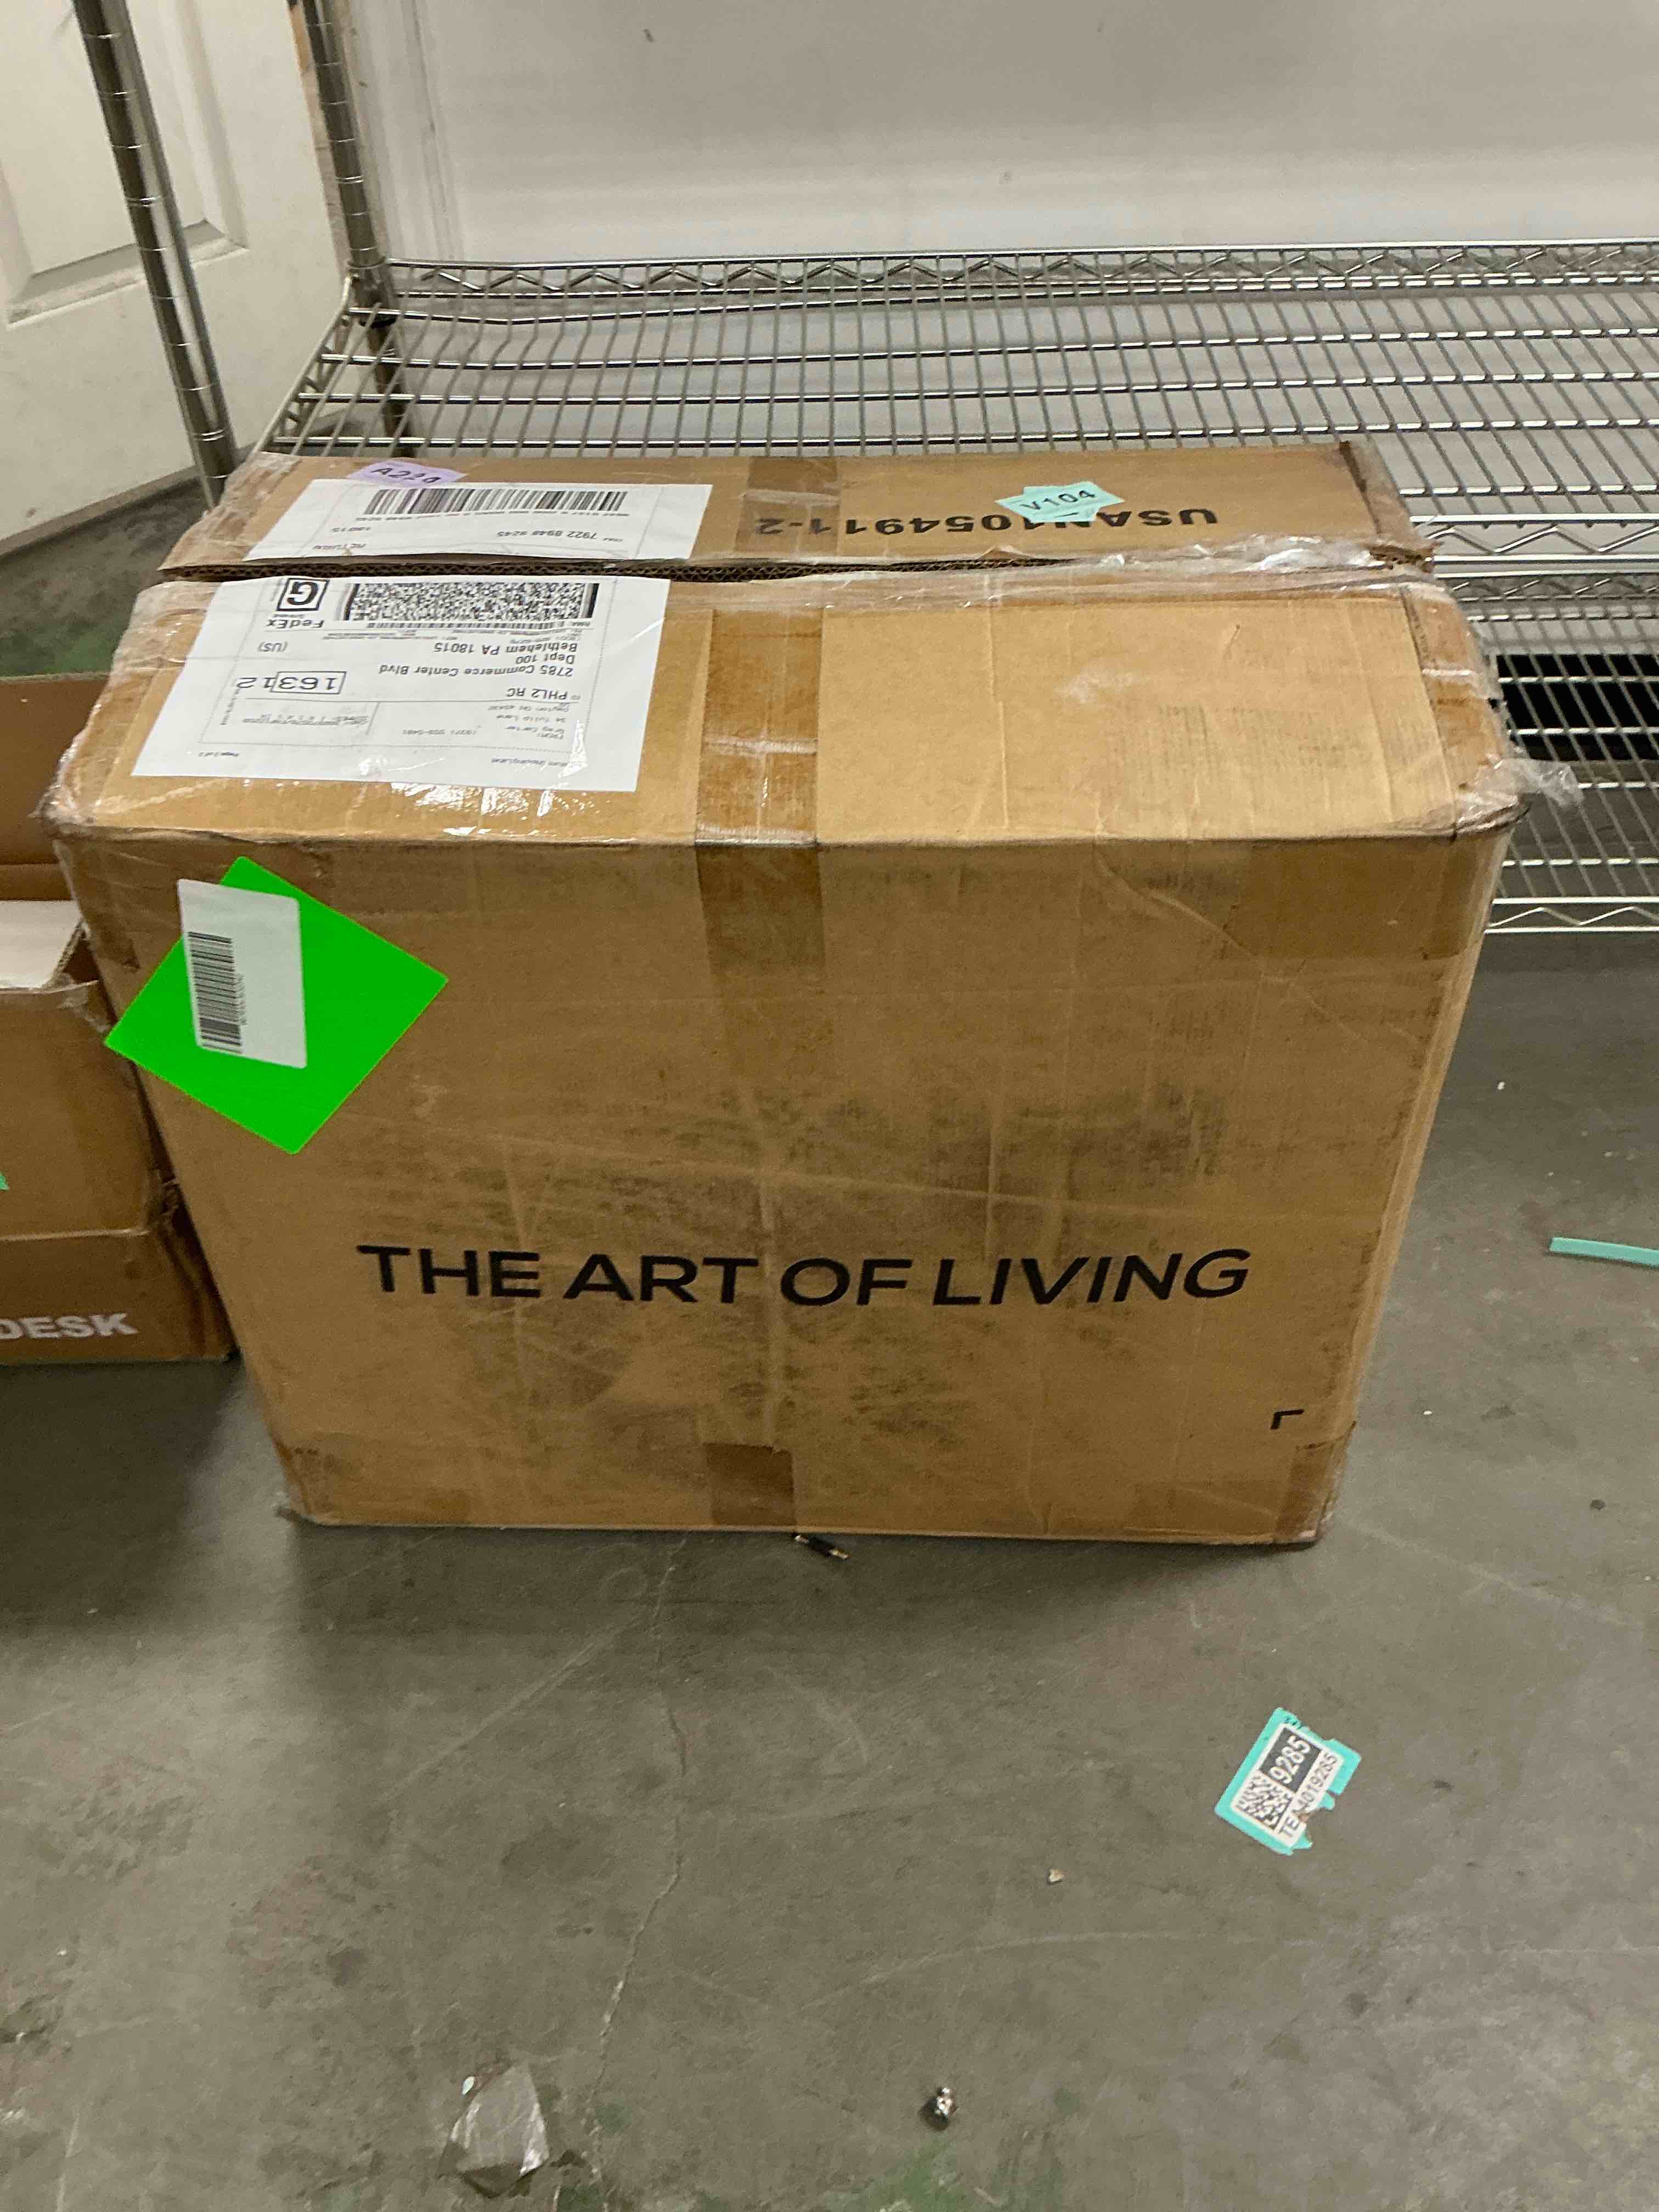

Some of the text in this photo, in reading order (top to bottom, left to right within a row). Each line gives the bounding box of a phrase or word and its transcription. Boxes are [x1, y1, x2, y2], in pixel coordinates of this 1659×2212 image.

[1019, 490, 1096, 510] V104
[755, 509, 1219, 535] USA1054911-2
[567, 531, 597, 539] 7922
[287, 582, 318, 606] G
[266, 619, 324, 628] FedEx
[258, 641, 287, 653] (US)
[433, 642, 577, 654] Bethlehem PA 18015
[516, 653, 575, 664] Dept 100
[379, 664, 574, 676] 2785 Commerce Center Blvd
[506, 688, 526, 697] RC
[531, 688, 568, 700] PHL2
[357, 1245, 1250, 1306] THE ART OF LIVING
[1269, 1735, 1311, 1784] 9285
[1280, 1752, 1338, 1838] TE4019285
